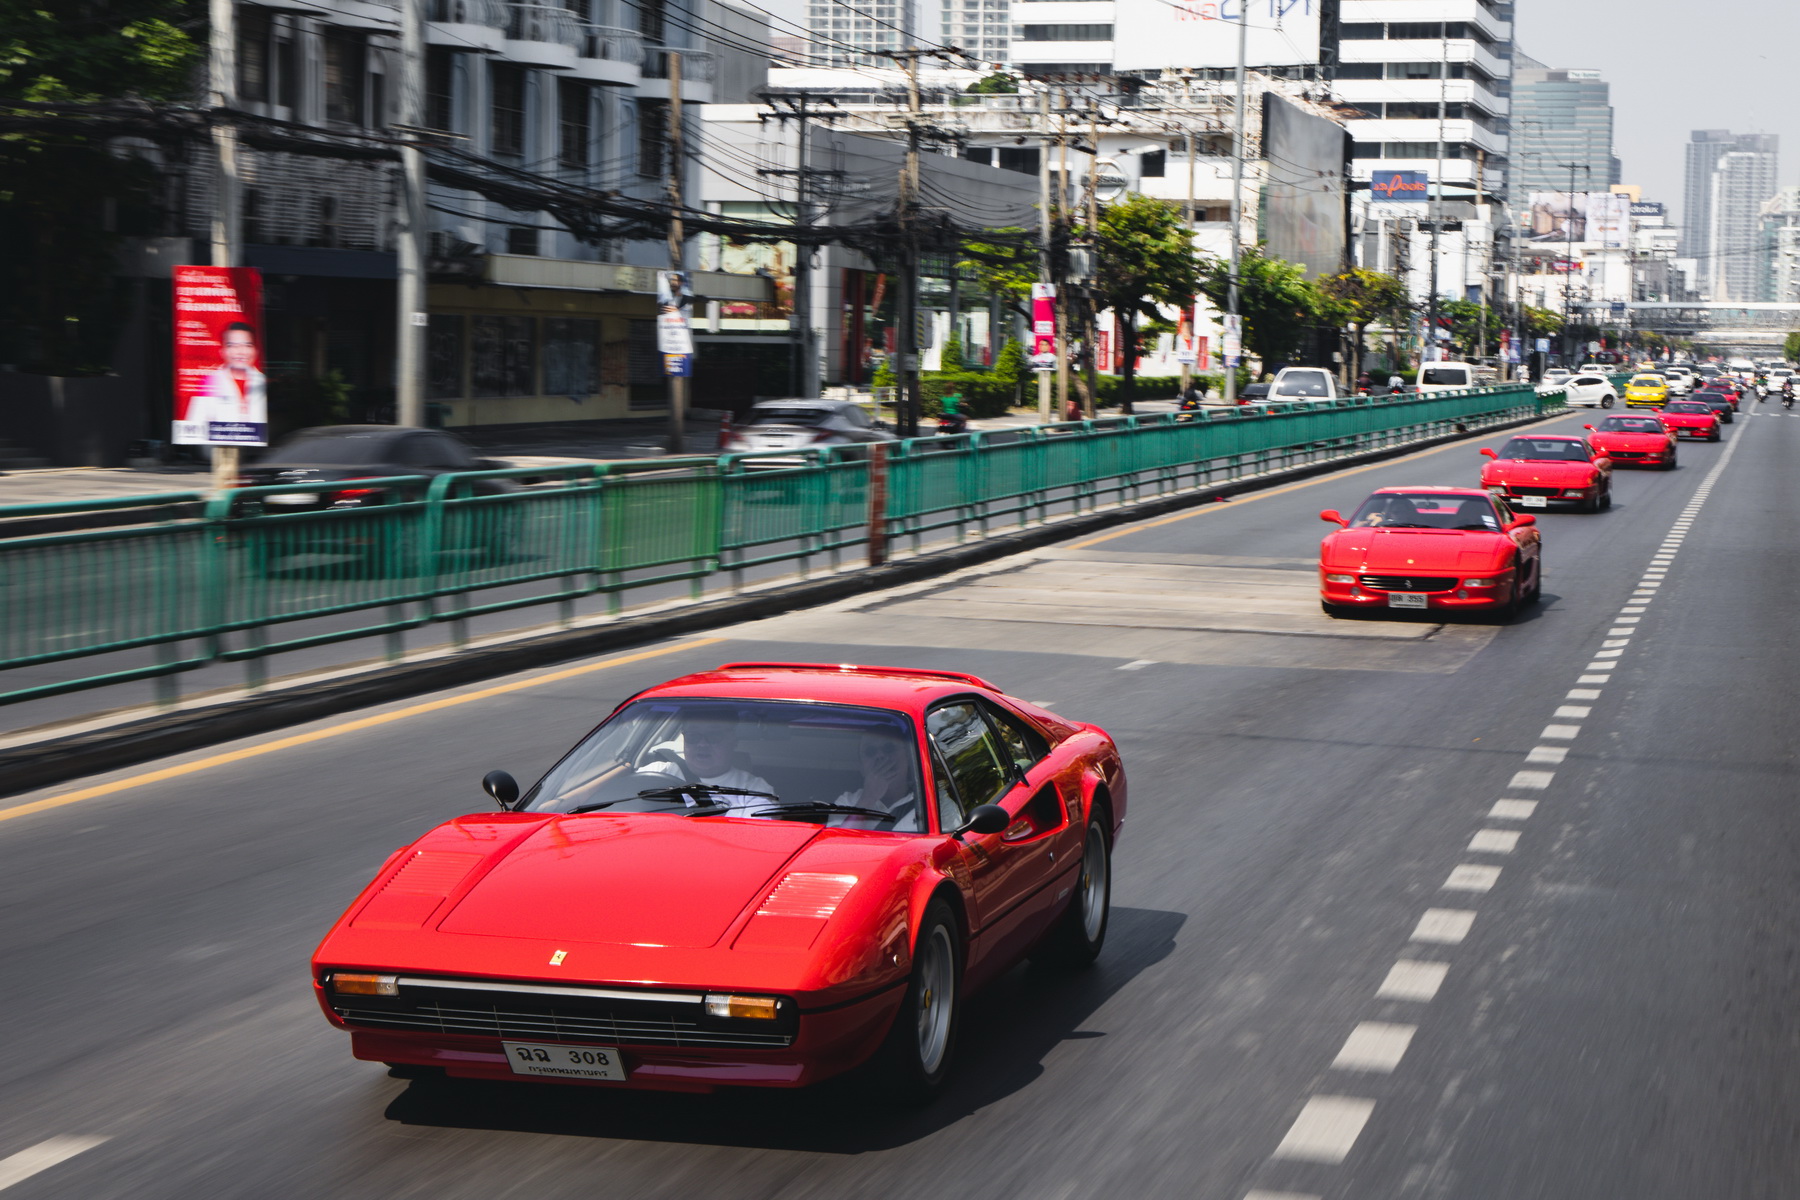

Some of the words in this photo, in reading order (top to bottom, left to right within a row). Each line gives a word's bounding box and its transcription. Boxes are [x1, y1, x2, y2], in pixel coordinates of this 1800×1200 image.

[516, 1047, 551, 1062] ฉฉ
[568, 1050, 610, 1066] 308
[528, 1065, 608, 1077] กรุงเทพมหานคร
